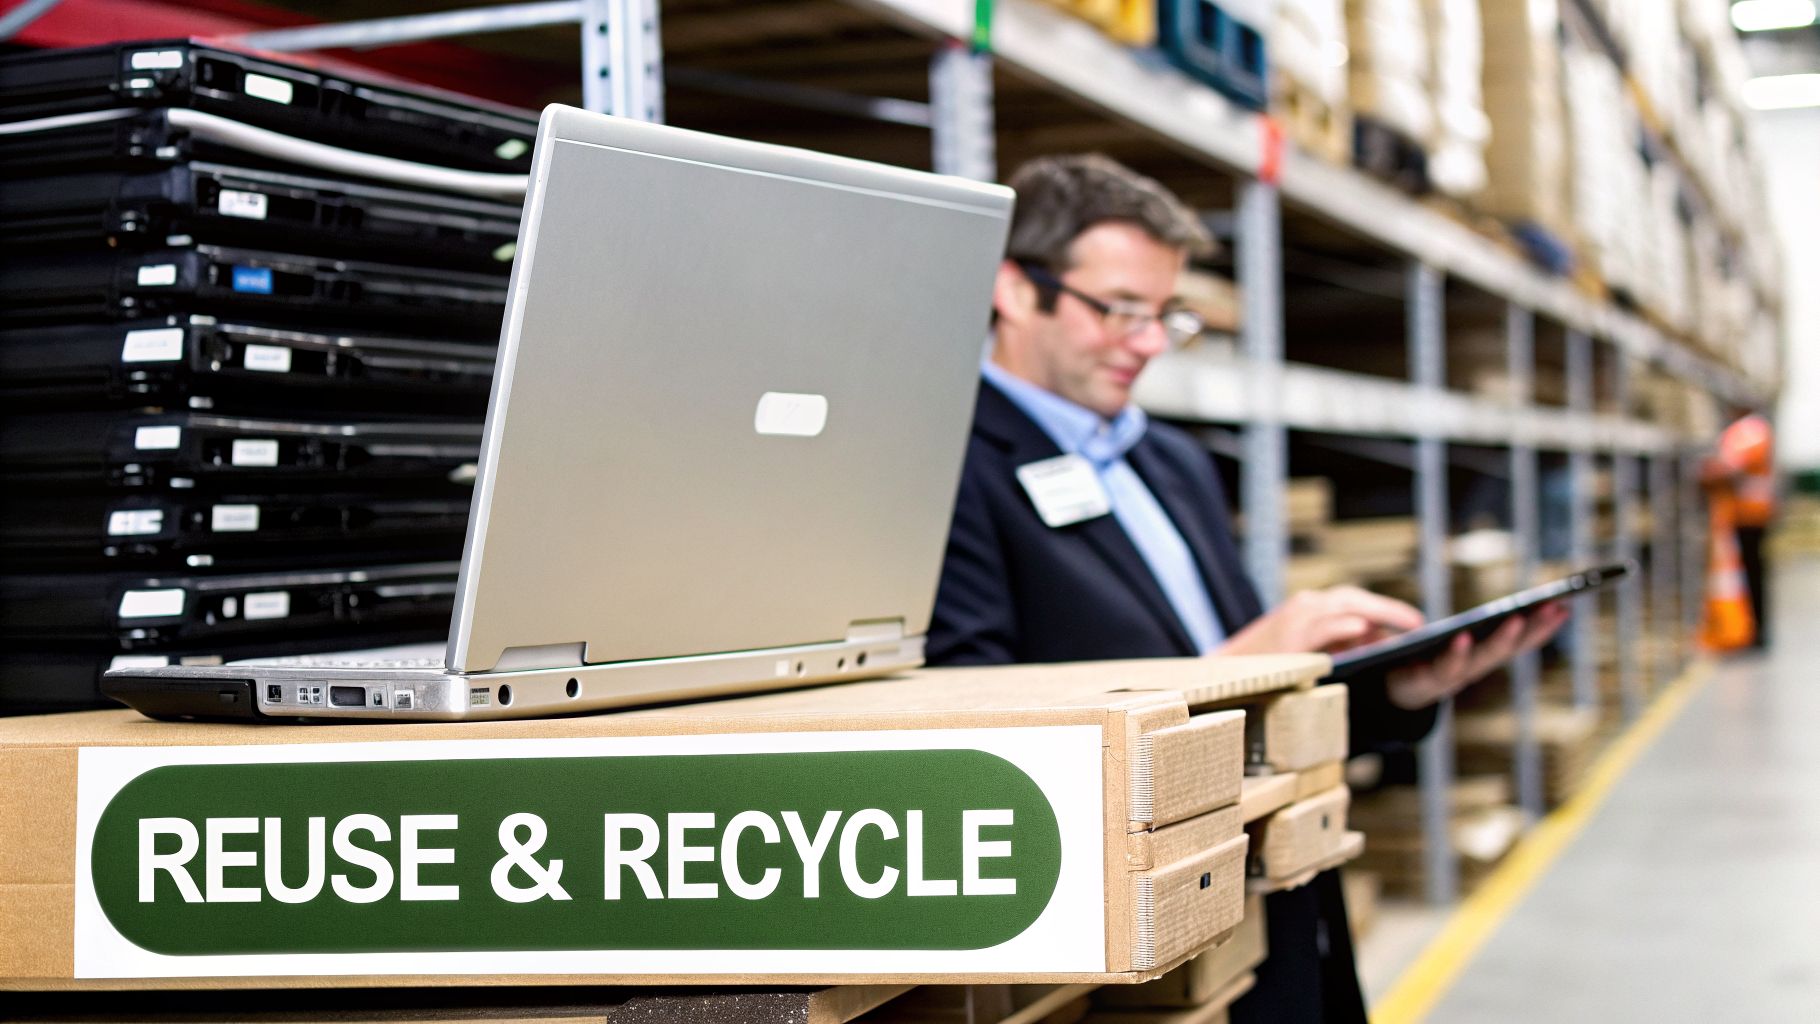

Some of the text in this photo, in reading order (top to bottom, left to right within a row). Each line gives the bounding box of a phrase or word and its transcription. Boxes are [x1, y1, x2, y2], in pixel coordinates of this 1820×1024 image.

[138, 808, 1018, 904] REUSE & RECYCLE
